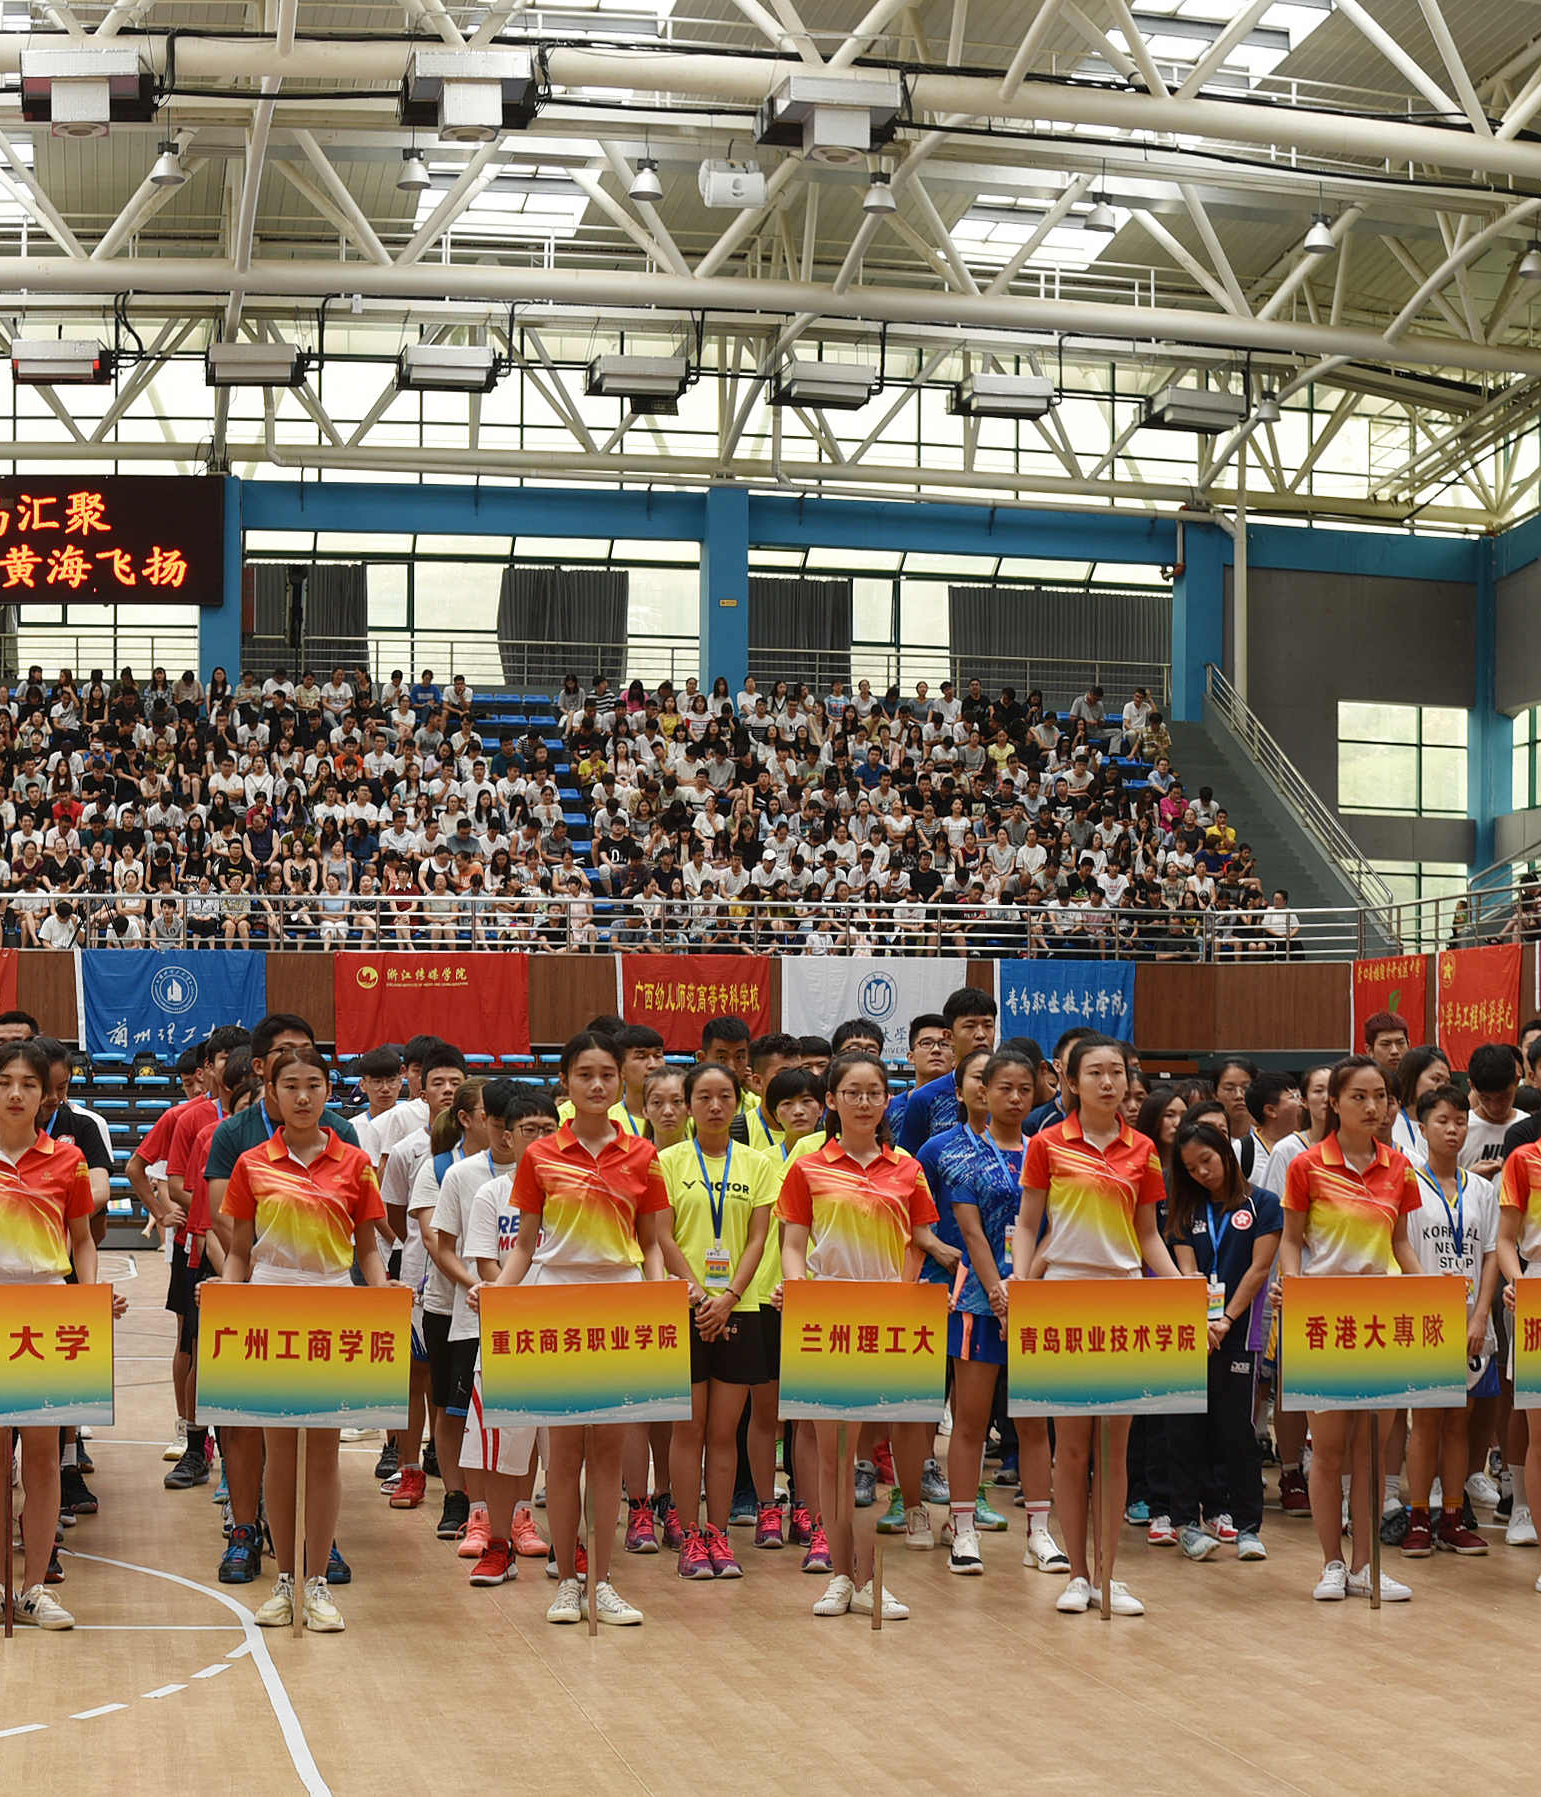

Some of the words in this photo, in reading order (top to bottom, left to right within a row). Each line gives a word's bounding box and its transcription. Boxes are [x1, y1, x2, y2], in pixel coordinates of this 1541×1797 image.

[212, 1326, 396, 1364] 广州工商学院
[491, 1323, 678, 1355] 重庆商务职业学院
[800, 1323, 935, 1356] 兰州理工大
[1020, 1323, 1196, 1355] 青岛职业技术学院
[1305, 1313, 1445, 1351] 香港大專隊
